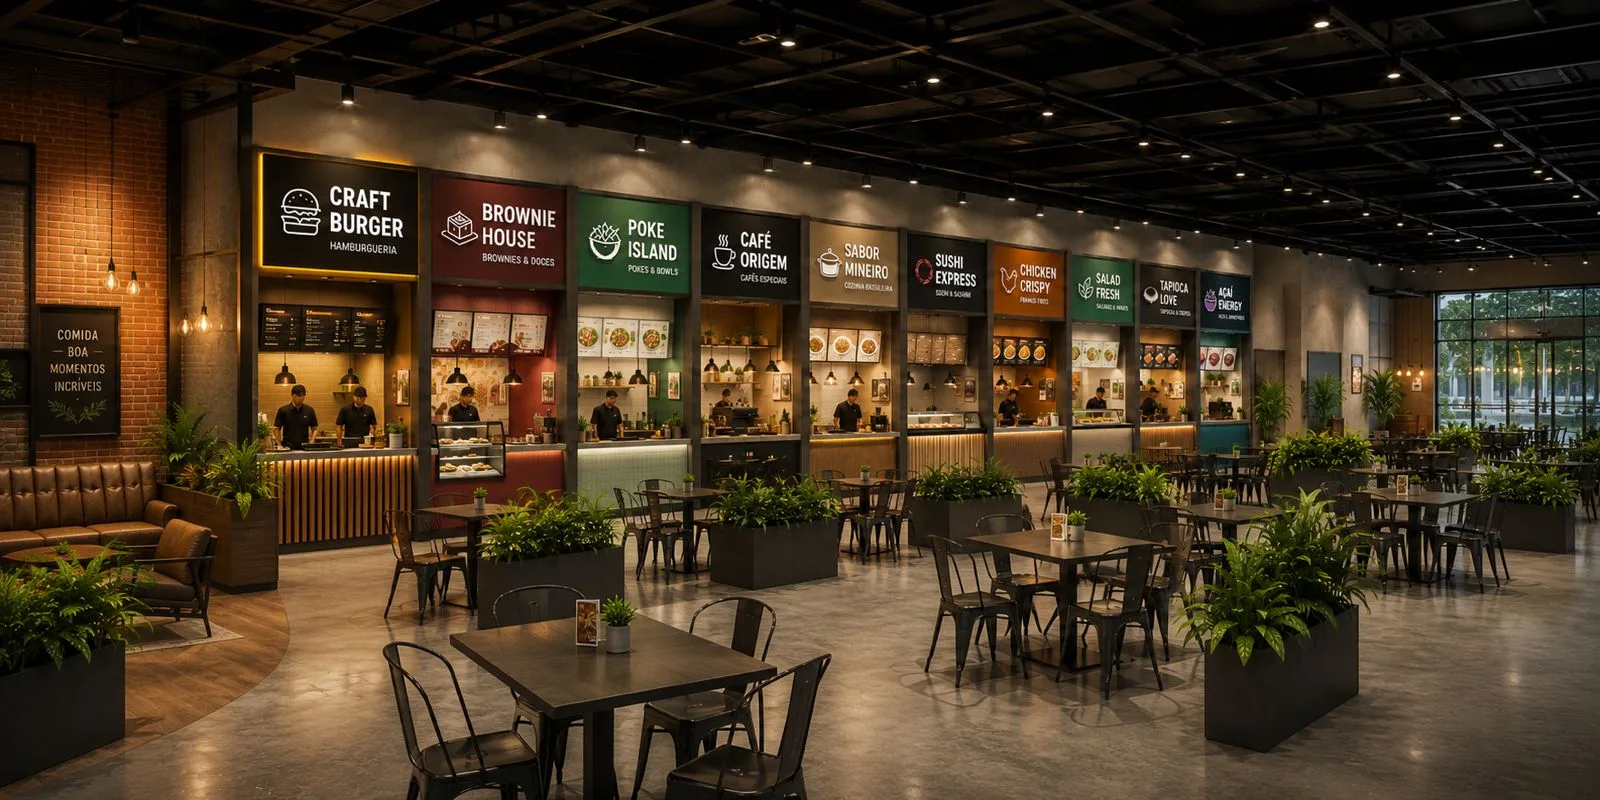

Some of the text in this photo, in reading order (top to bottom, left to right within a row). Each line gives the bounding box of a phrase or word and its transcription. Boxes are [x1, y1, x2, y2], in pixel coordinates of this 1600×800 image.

[330, 185, 391, 210] CRAFT
[482, 202, 556, 228] BROWNIE
[330, 212, 403, 238] BURGER
[628, 218, 665, 239] POKE
[482, 227, 536, 249] HOUSE
[740, 230, 771, 249] CAFÉ
[330, 241, 397, 255] HAMBURGUERIA
[628, 240, 677, 262] ISLAND
[845, 243, 880, 261] SABOR
[482, 253, 555, 267] BROWNIES & DOCES
[740, 251, 788, 271] ORIGEM
[935, 253, 964, 269] SUSHI
[628, 264, 649, 274] POKES
[656, 267, 679, 276] BOWLS
[740, 272, 759, 283] CAFÉS
[845, 261, 888, 280] MINEIRO
[1020, 264, 1057, 279] CHICKEN
[935, 270, 977, 288] EXPRESS
[1096, 272, 1121, 286] SALAD
[1160, 280, 1189, 293] TAPIOCA
[1020, 280, 1050, 295] CRISPY
[1096, 287, 1120, 300] FRESH
[1218, 285, 1233, 299] AÇAÍ
[1160, 293, 1177, 306] LOVE
[57, 329, 99, 341] COMIDA
[68, 346, 88, 357] BOA
[50, 363, 106, 374] MOMENTOS
[54, 377, 102, 392] INCRÍVEIS
